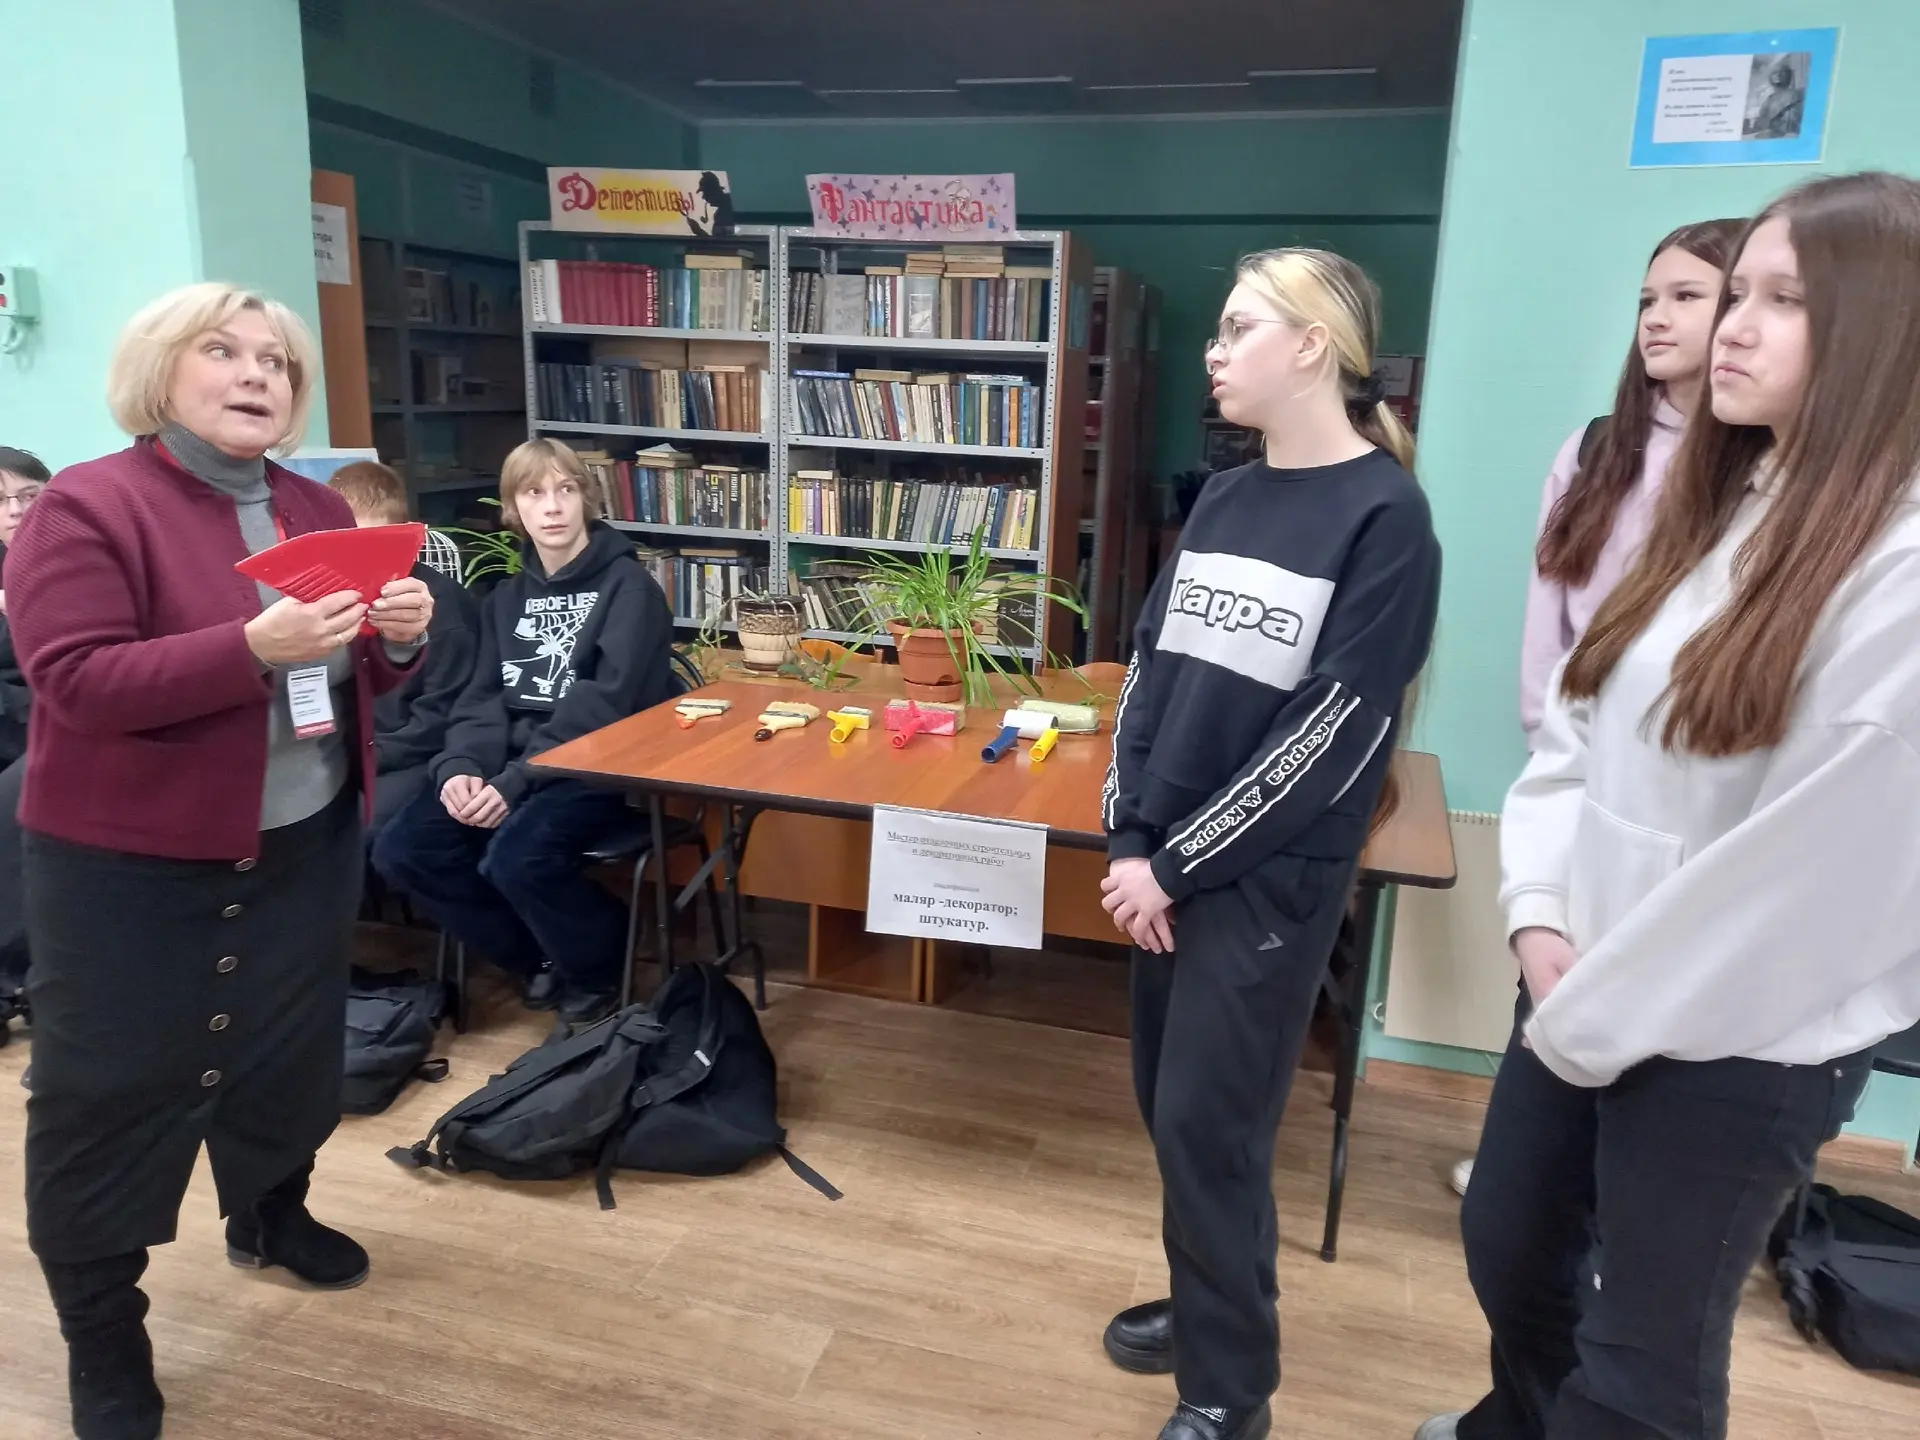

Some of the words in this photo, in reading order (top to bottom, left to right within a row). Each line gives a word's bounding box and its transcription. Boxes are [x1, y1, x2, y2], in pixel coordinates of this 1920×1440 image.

[557, 171, 695, 212] Детективы
[819, 181, 985, 225] Фантастика
[546, 596, 567, 611] OF
[1265, 722, 1330, 786] Kappa
[887, 831, 919, 843] Мастер
[1180, 805, 1246, 857] Kappa
[981, 856, 1005, 867] работ
[893, 893, 936, 908] маляр
[919, 914, 989, 932] штукатур.
